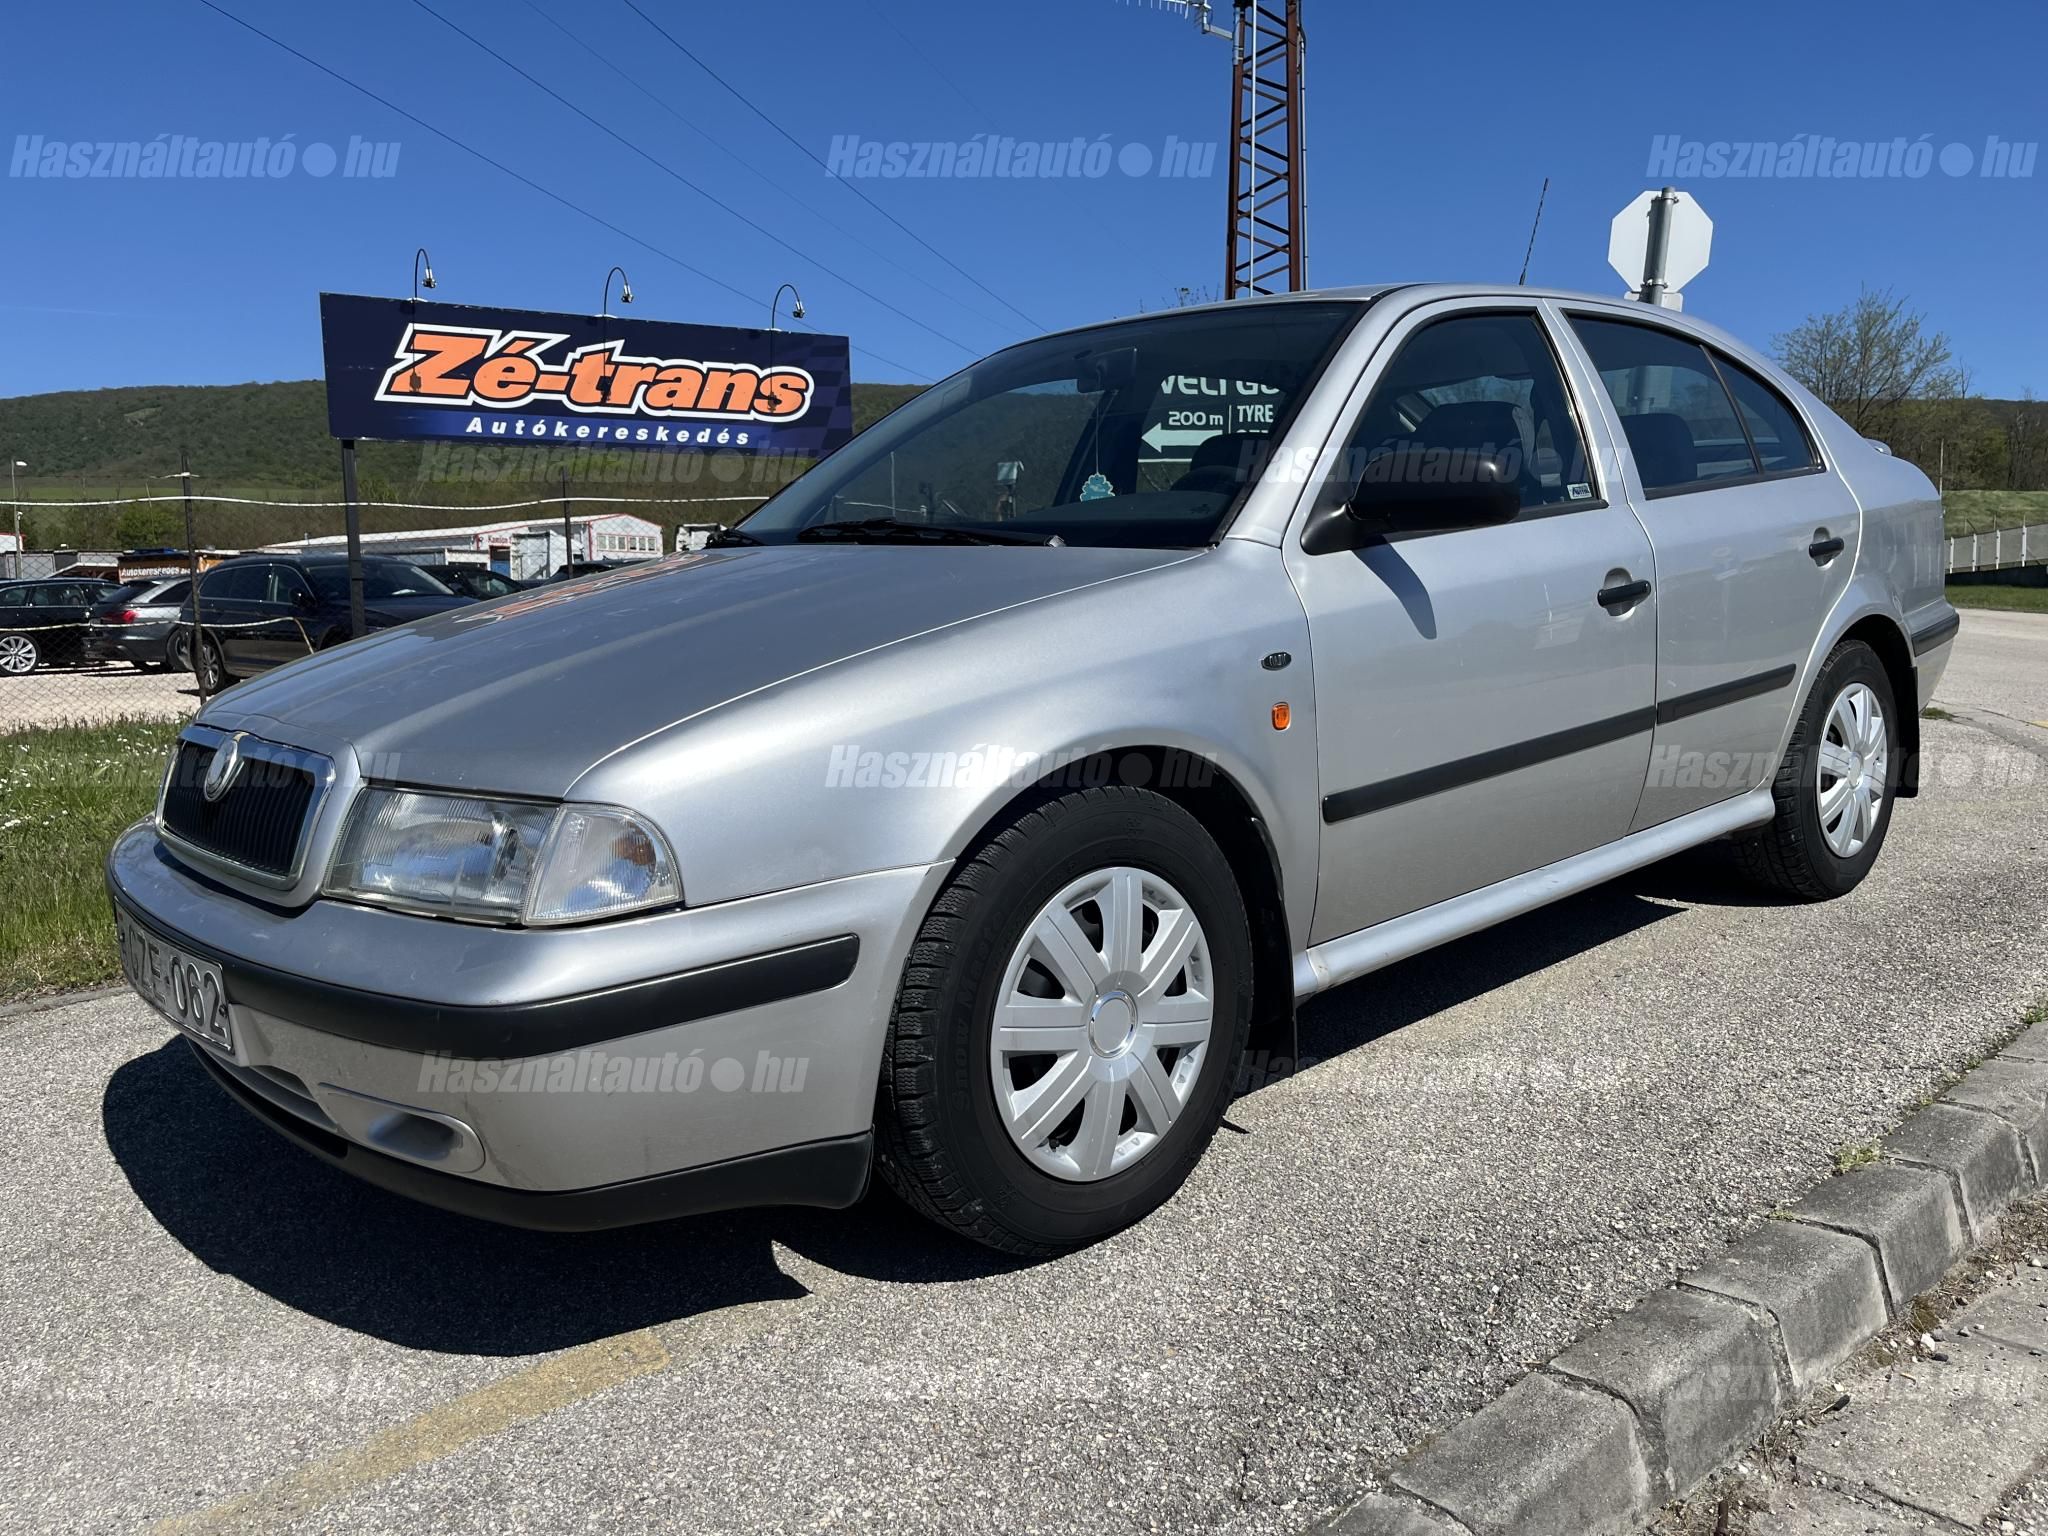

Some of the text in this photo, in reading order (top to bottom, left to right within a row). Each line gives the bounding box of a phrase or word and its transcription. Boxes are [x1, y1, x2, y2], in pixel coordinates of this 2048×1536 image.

[376, 323, 814, 422] Zé-trans
[1168, 411, 1224, 426] 200 m
[1237, 404, 1274, 423] TYRE
[466, 416, 750, 445] Autókereskedés
